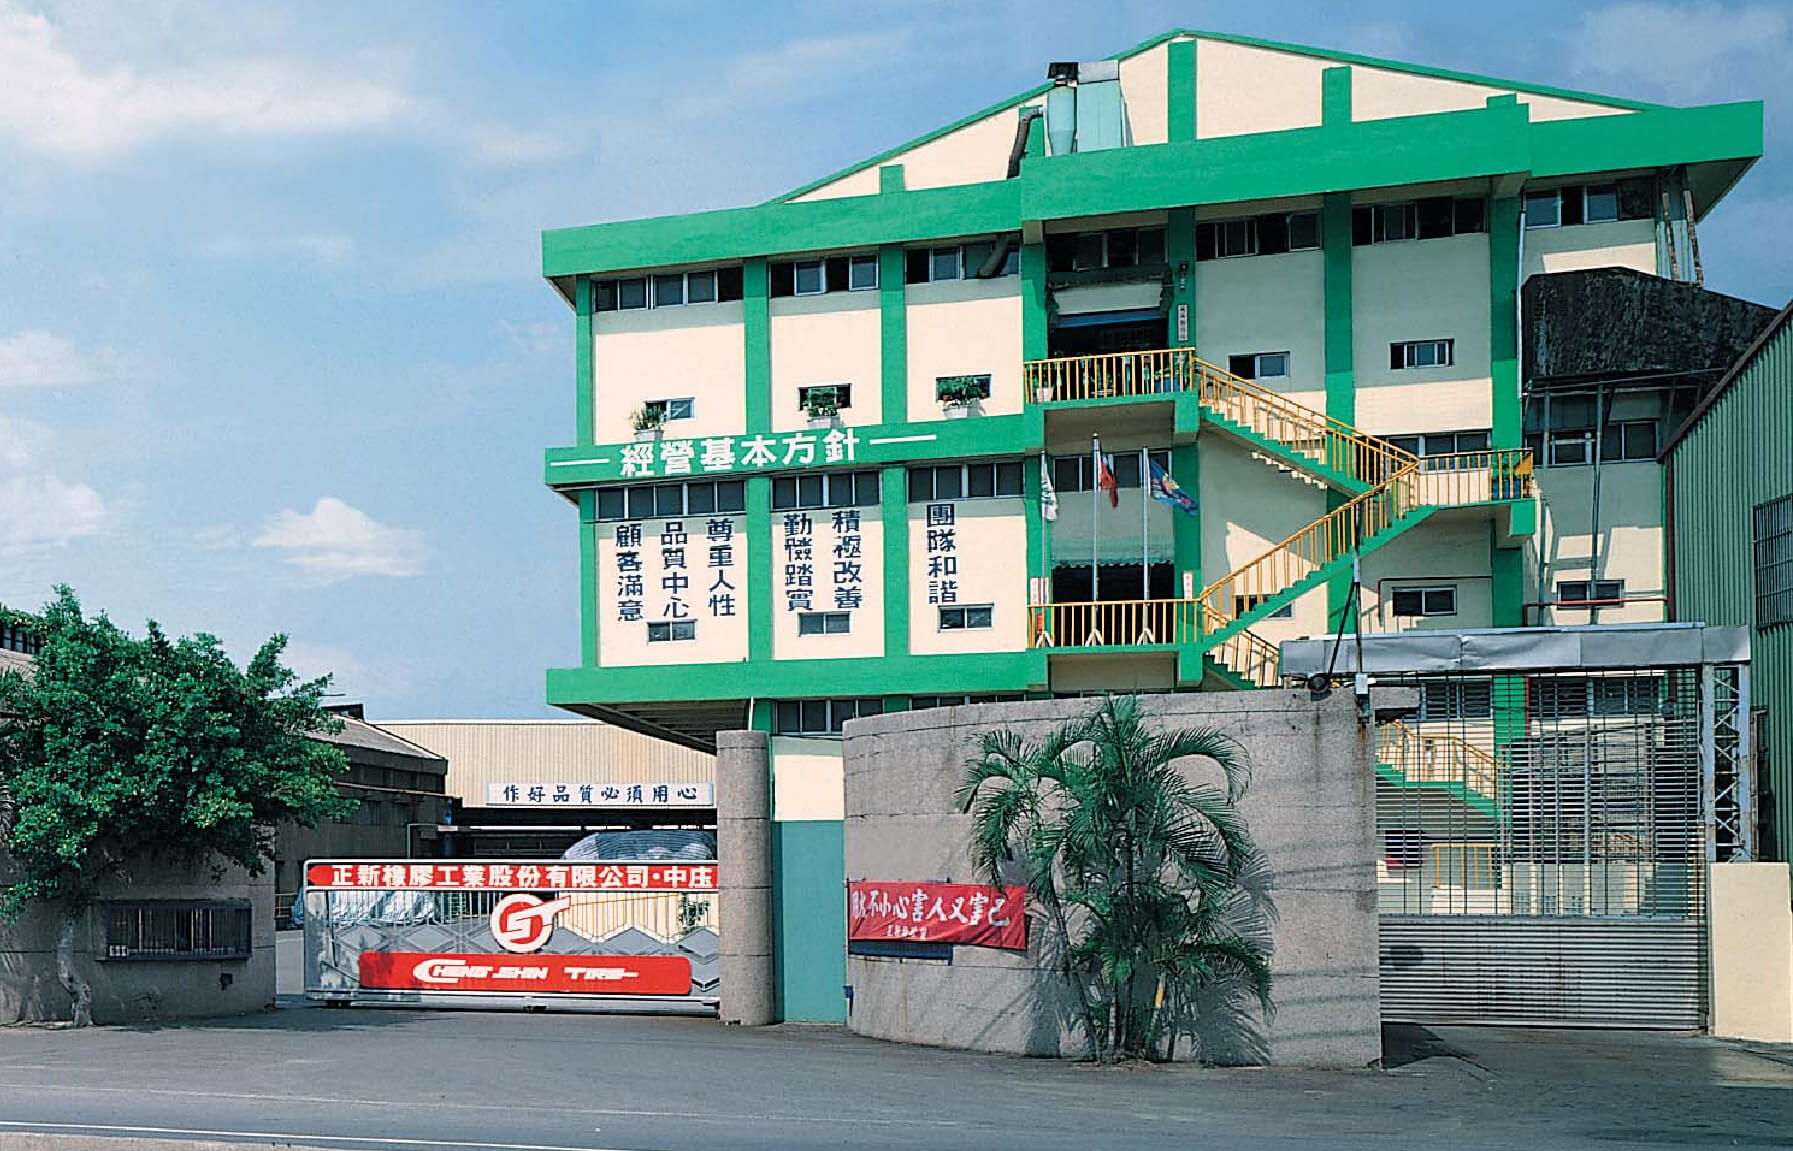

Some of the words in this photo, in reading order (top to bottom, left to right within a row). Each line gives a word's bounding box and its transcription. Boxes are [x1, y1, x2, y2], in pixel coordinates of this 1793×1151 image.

[620, 428, 859, 477] 經營基本方針
[615, 523, 643, 622] 顧客滿意
[661, 521, 689, 619] 品質中心
[706, 518, 735, 617] 尊重人性
[831, 510, 862, 608] 積極改善
[926, 503, 957, 604] 團隊和諧
[503, 784, 697, 803] 作好品質必須用心
